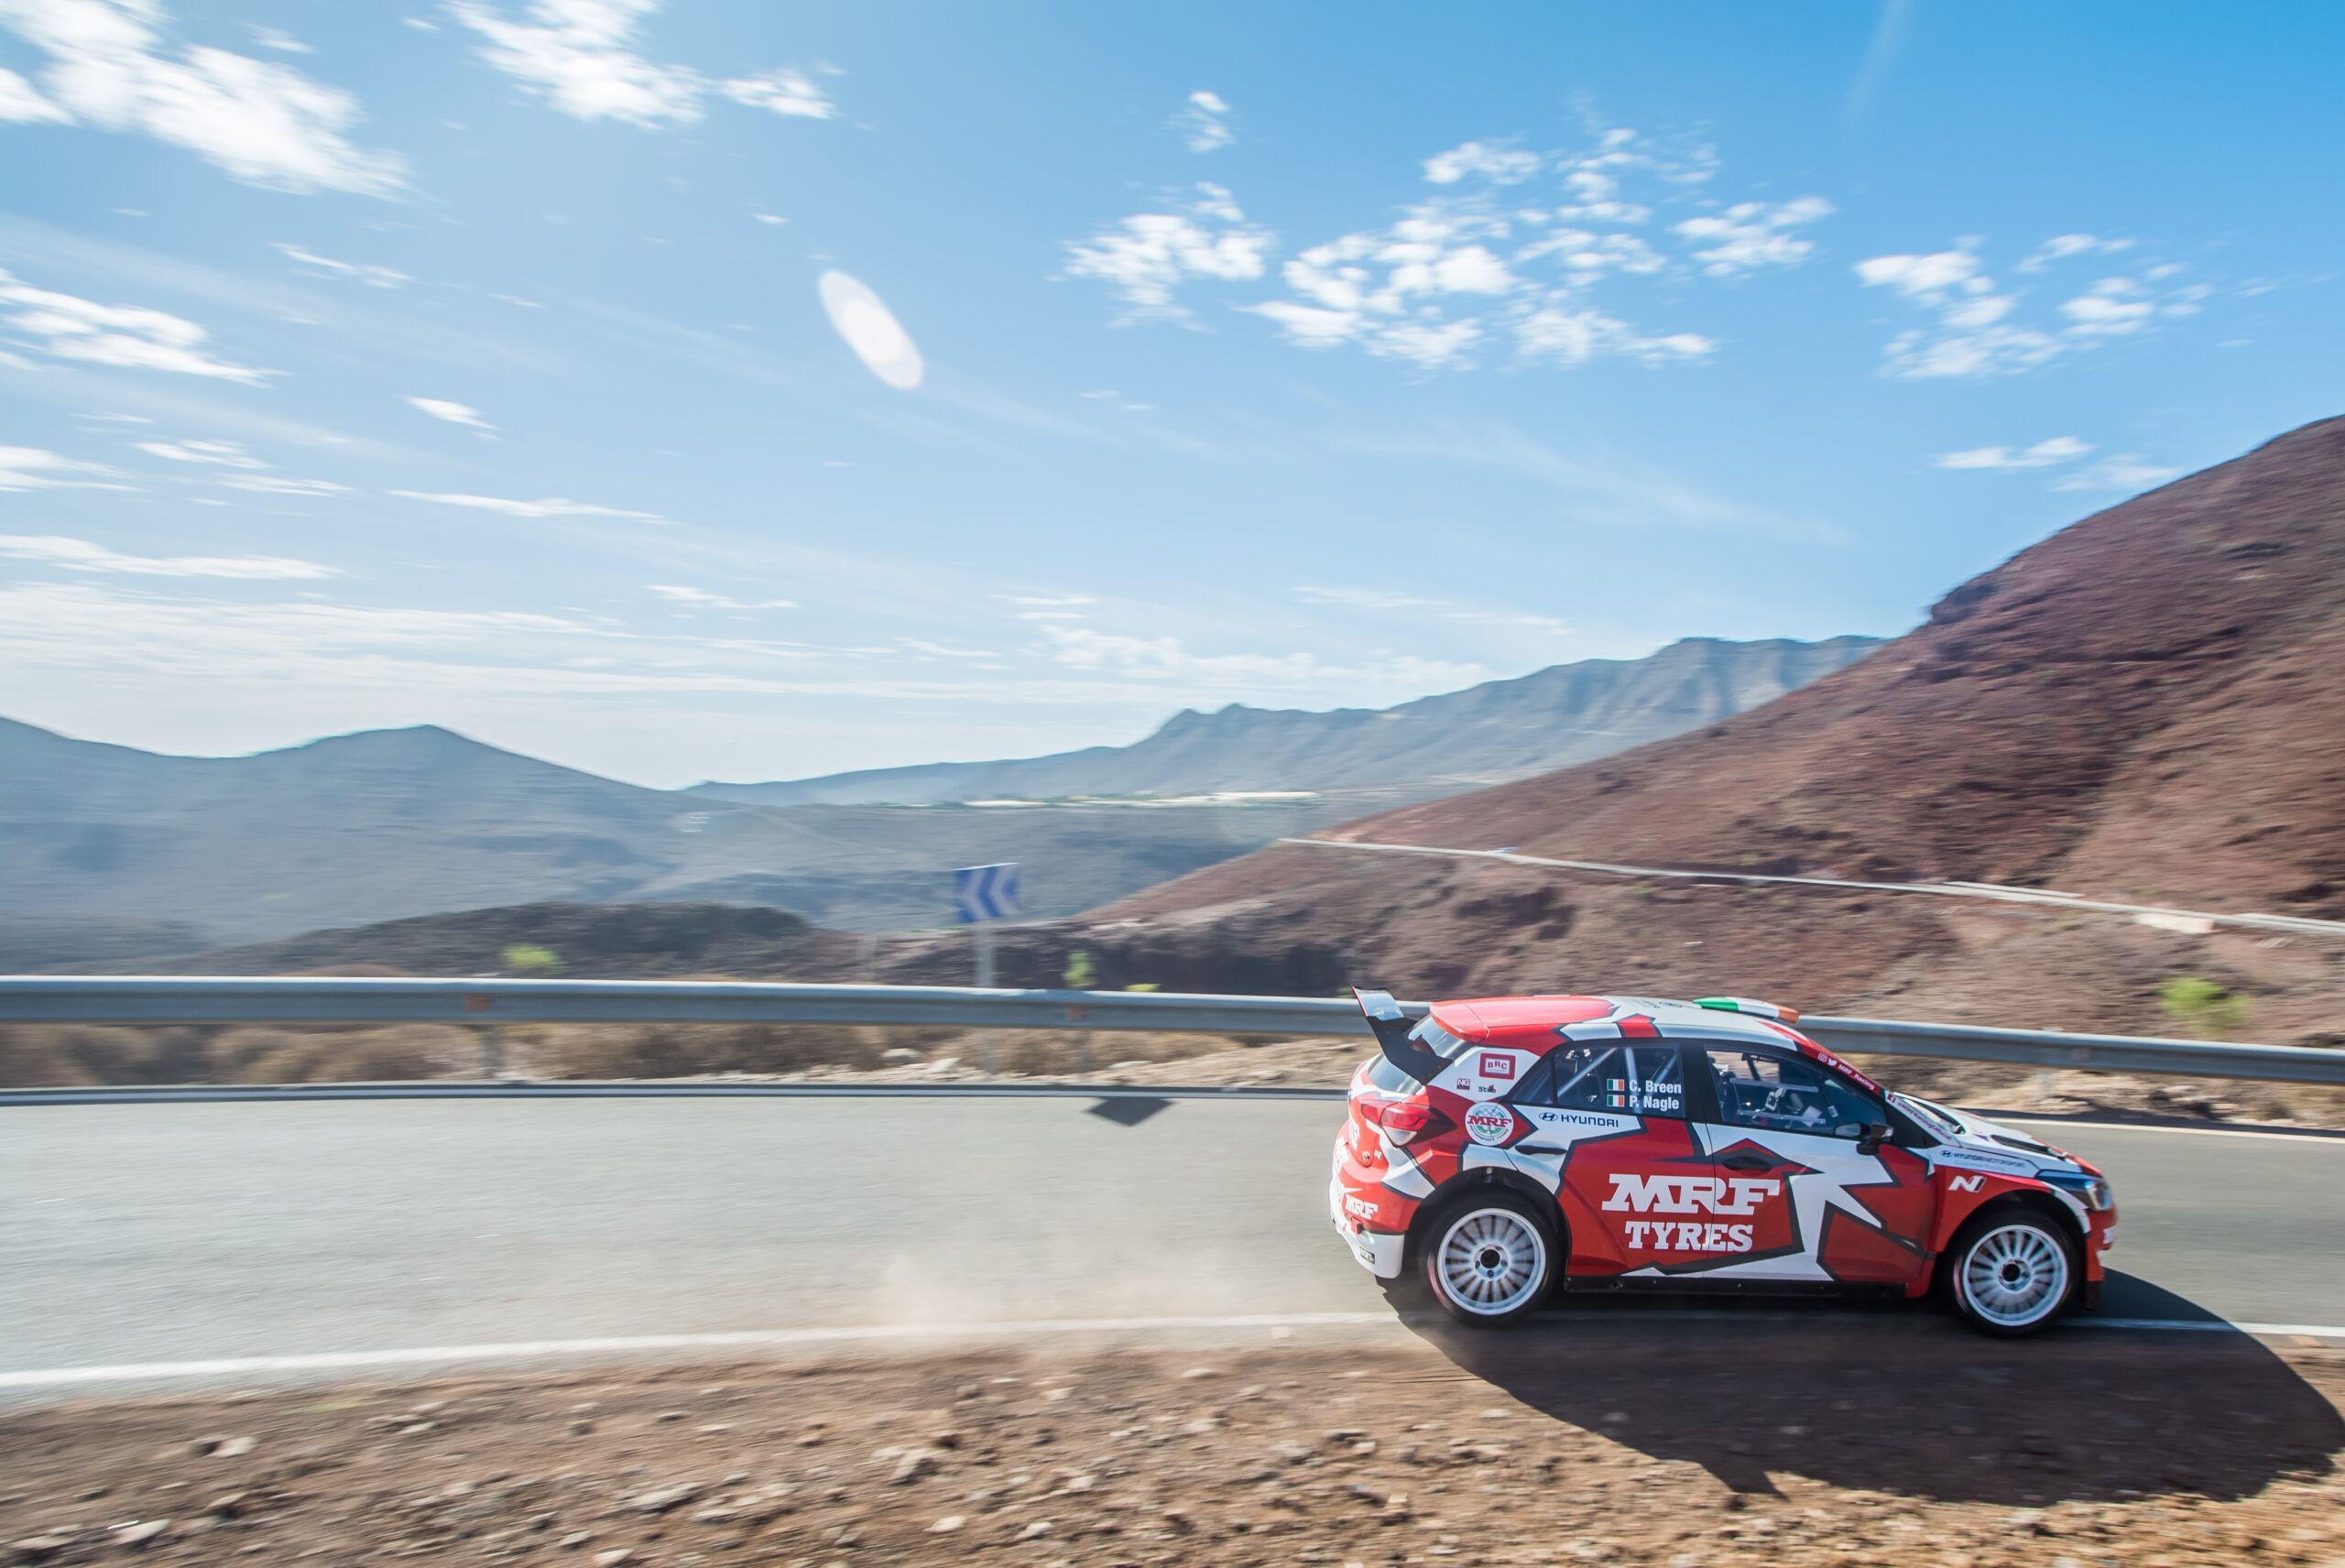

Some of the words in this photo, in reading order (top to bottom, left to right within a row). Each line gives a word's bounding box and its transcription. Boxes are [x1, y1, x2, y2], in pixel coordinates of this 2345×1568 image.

[1488, 1061, 1508, 1070] BRC
[1629, 1079, 1641, 1092] C.
[1645, 1080, 1682, 1094] Breen
[1629, 1094, 1640, 1107] P.
[1643, 1095, 1679, 1112] Nagle
[1467, 1115, 1511, 1127] MRF
[1561, 1114, 1619, 1127] HYUNDAI
[1601, 1173, 1781, 1215] MRF
[1345, 1193, 1379, 1220] MRF
[1624, 1221, 1753, 1252] TYRES
